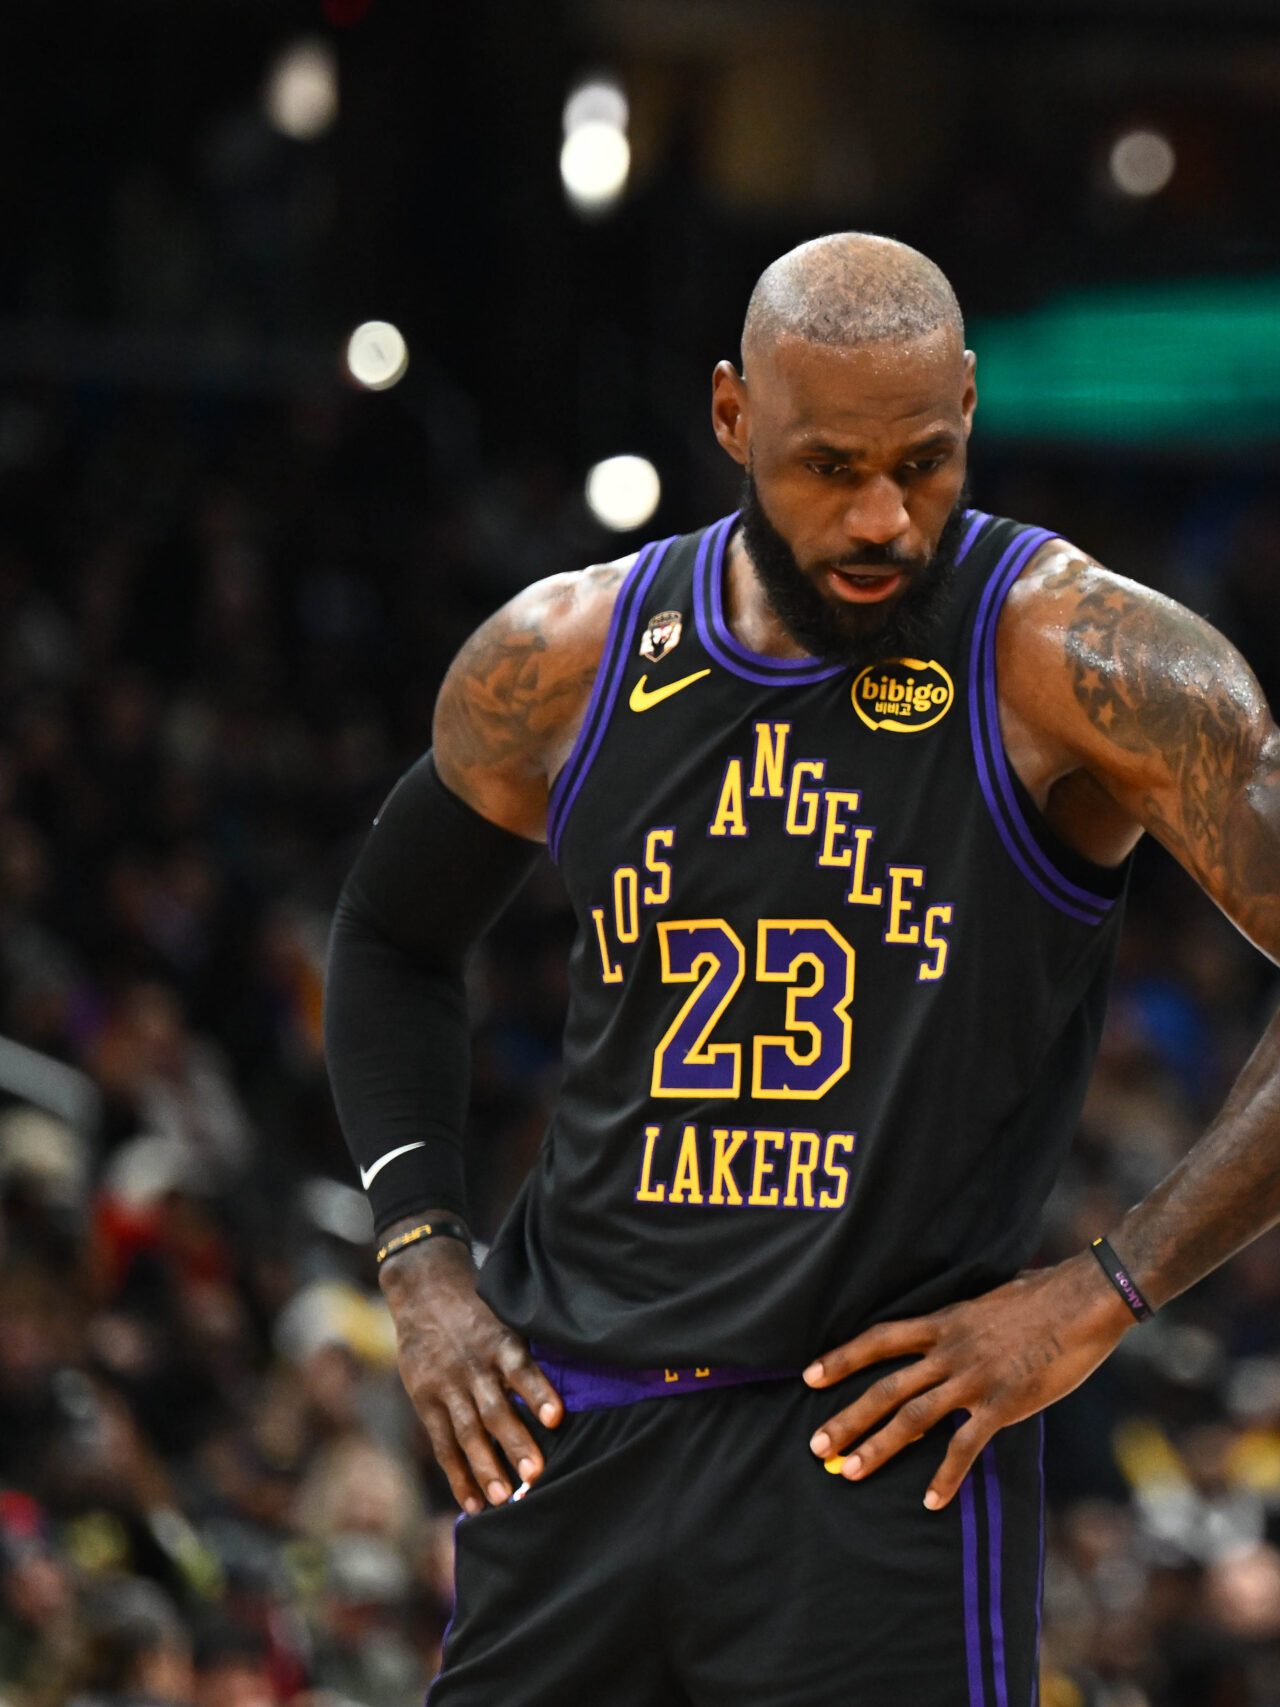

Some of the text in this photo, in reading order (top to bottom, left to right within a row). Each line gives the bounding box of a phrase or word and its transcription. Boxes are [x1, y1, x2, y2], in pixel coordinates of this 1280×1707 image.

[862, 675, 948, 712] bibigo
[874, 702, 911, 716] 비비고
[591, 720, 954, 984] LOS ANGELES
[650, 918, 856, 1100] 23
[633, 1123, 856, 1210] LAKERS
